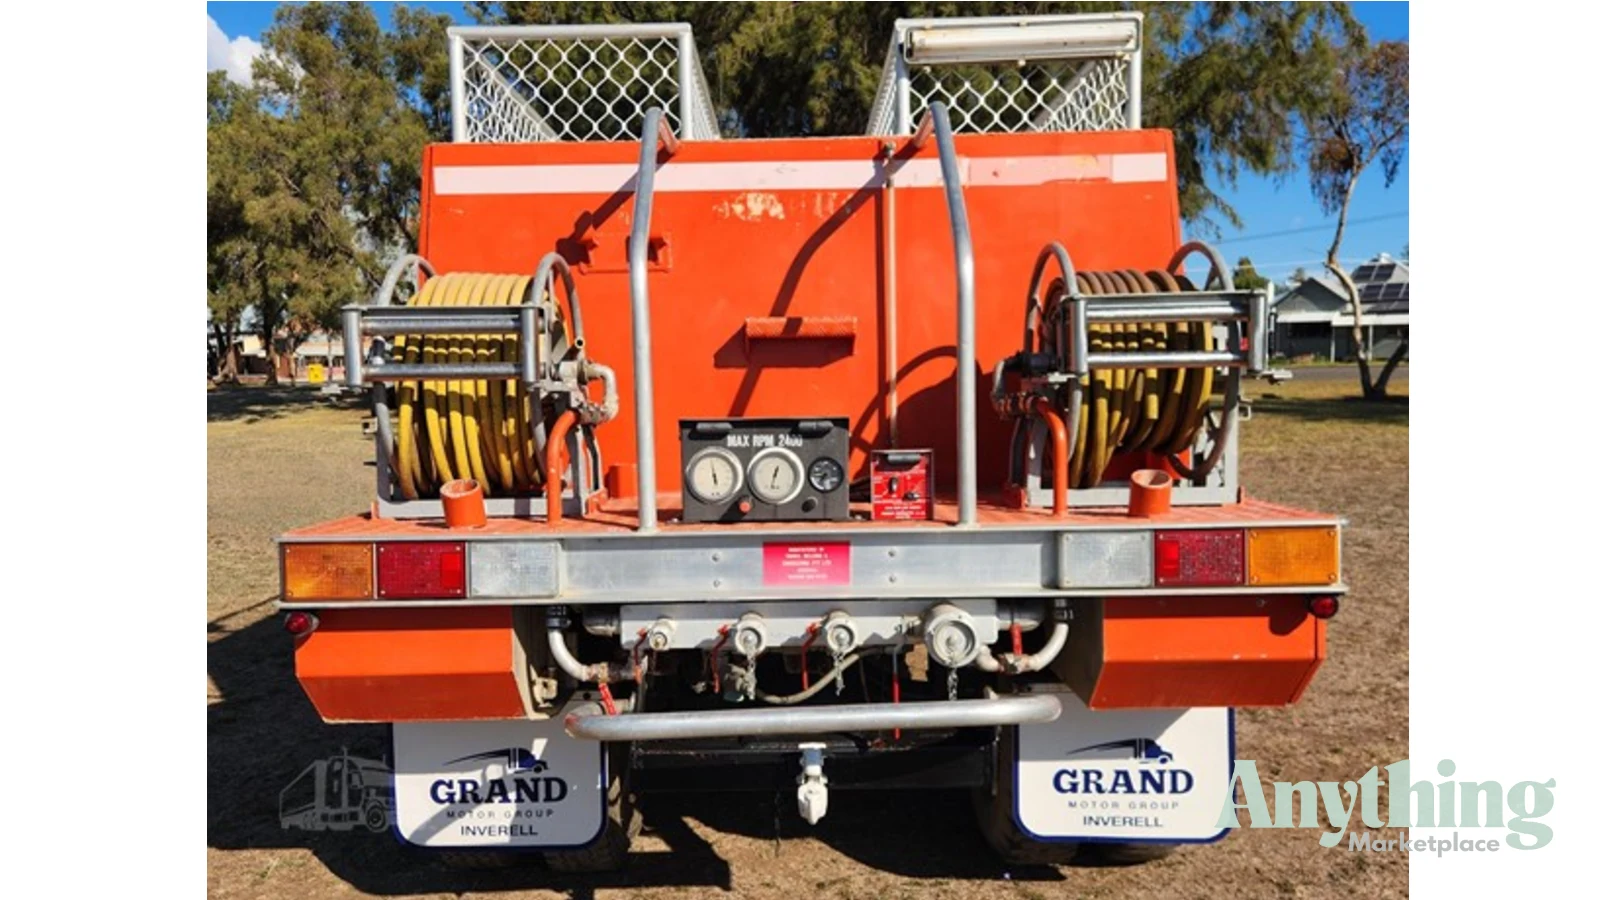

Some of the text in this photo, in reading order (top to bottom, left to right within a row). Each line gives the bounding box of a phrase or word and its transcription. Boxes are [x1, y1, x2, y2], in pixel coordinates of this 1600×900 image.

[726, 433, 750, 447] MAX
[752, 433, 774, 447] RPM
[1052, 768, 1195, 795] GRAND
[429, 776, 569, 805] GRAND
[1068, 800, 1180, 810] MOTOR GROUP
[446, 808, 555, 819] MOTOR GROUP
[1082, 815, 1163, 828] INVERELL
[460, 823, 539, 837] INVERELL
